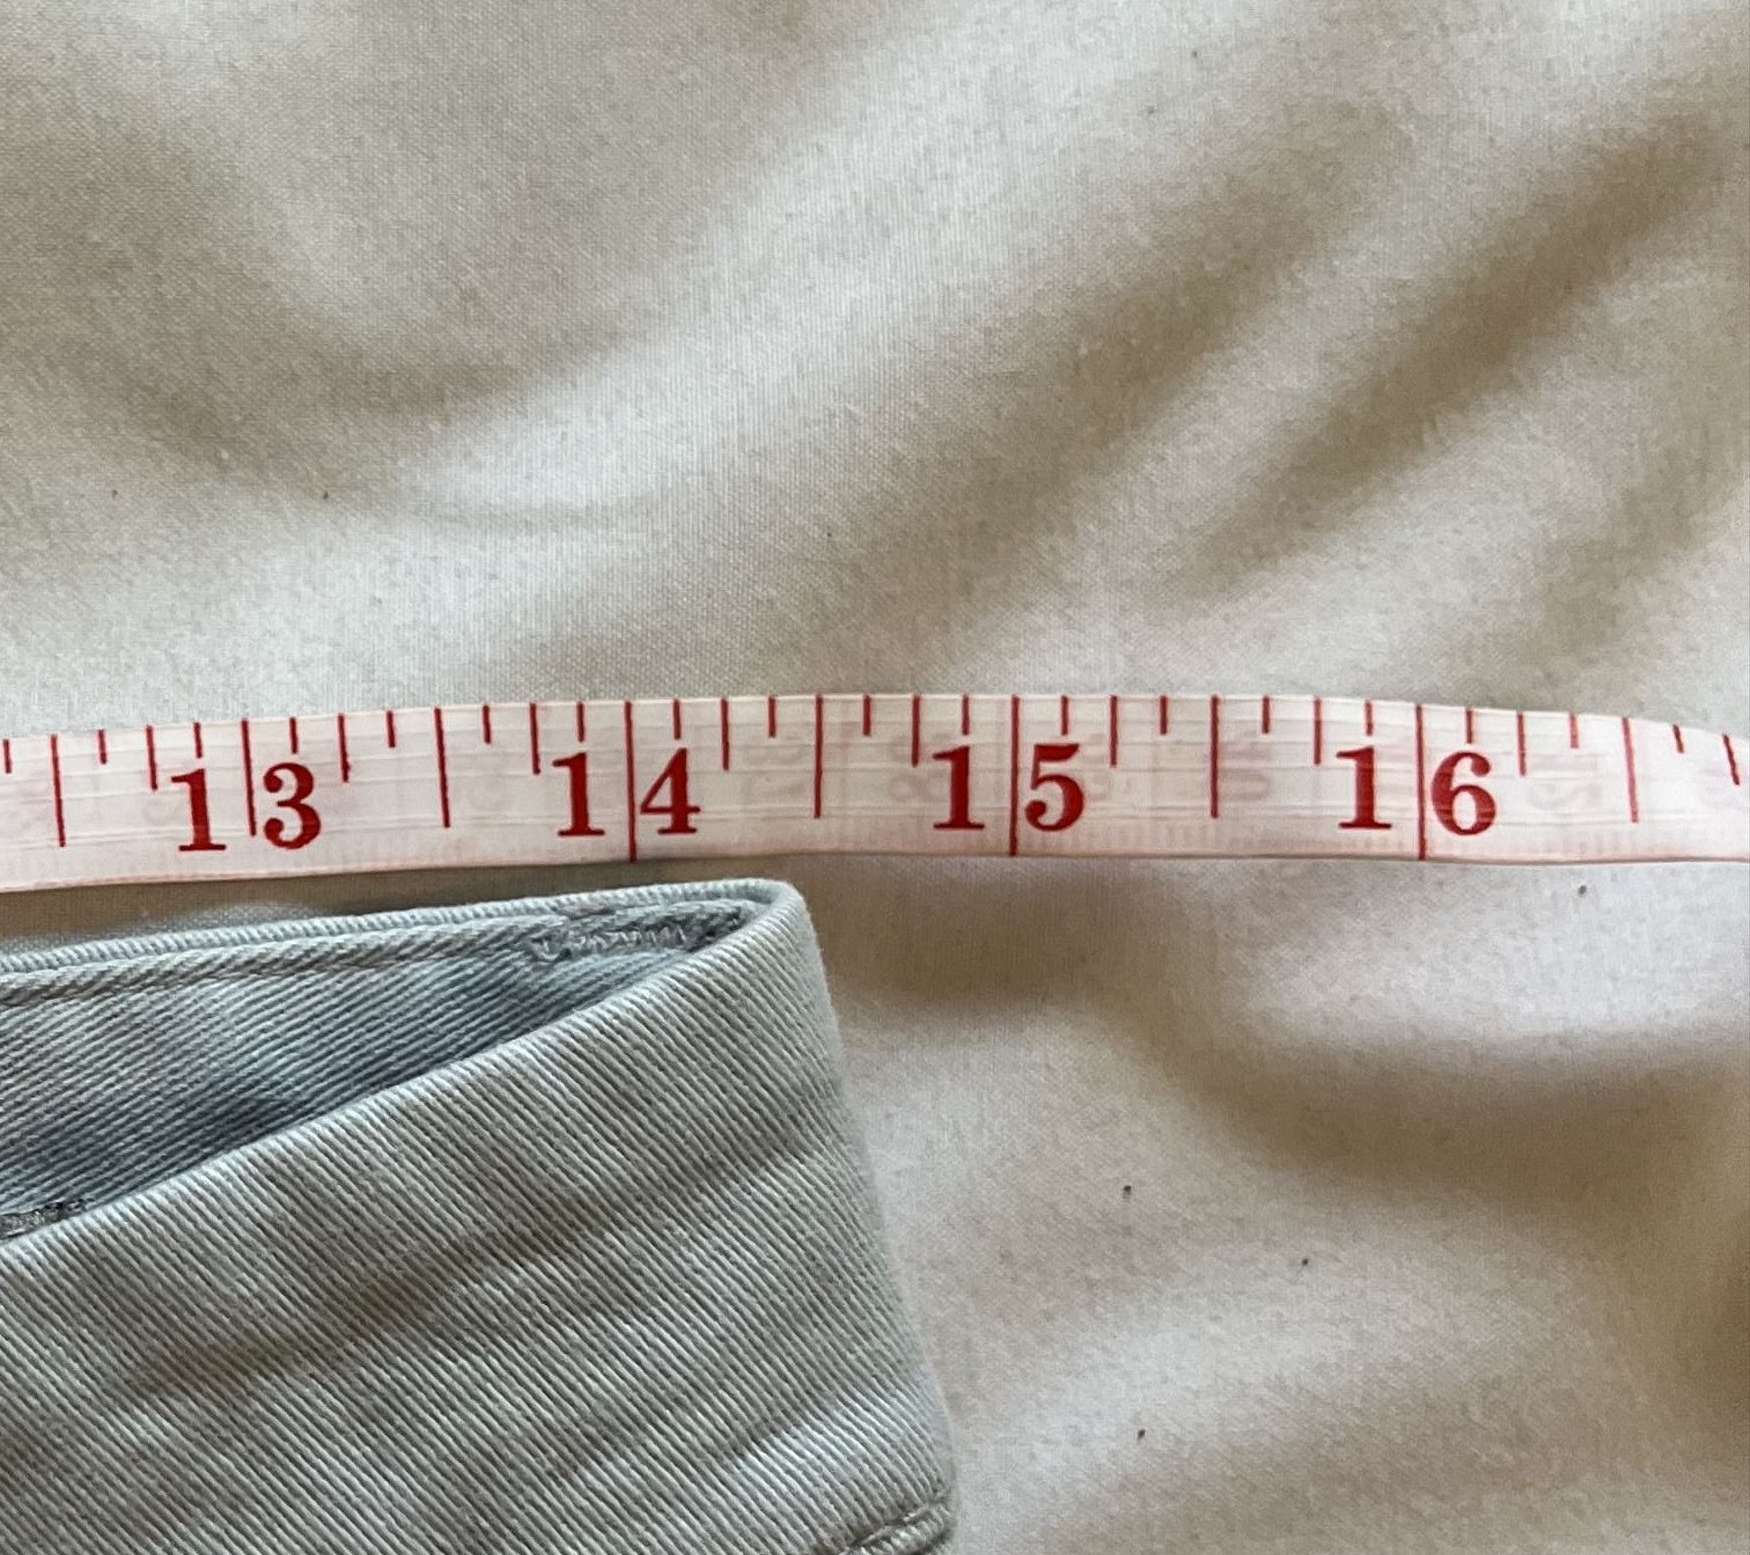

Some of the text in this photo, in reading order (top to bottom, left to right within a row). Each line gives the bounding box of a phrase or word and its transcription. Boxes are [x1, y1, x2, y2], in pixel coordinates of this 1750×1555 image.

[171, 762, 323, 852] 13
[554, 748, 700, 836] 14
[931, 742, 1086, 832] 15
[1337, 746, 1497, 835] 16
